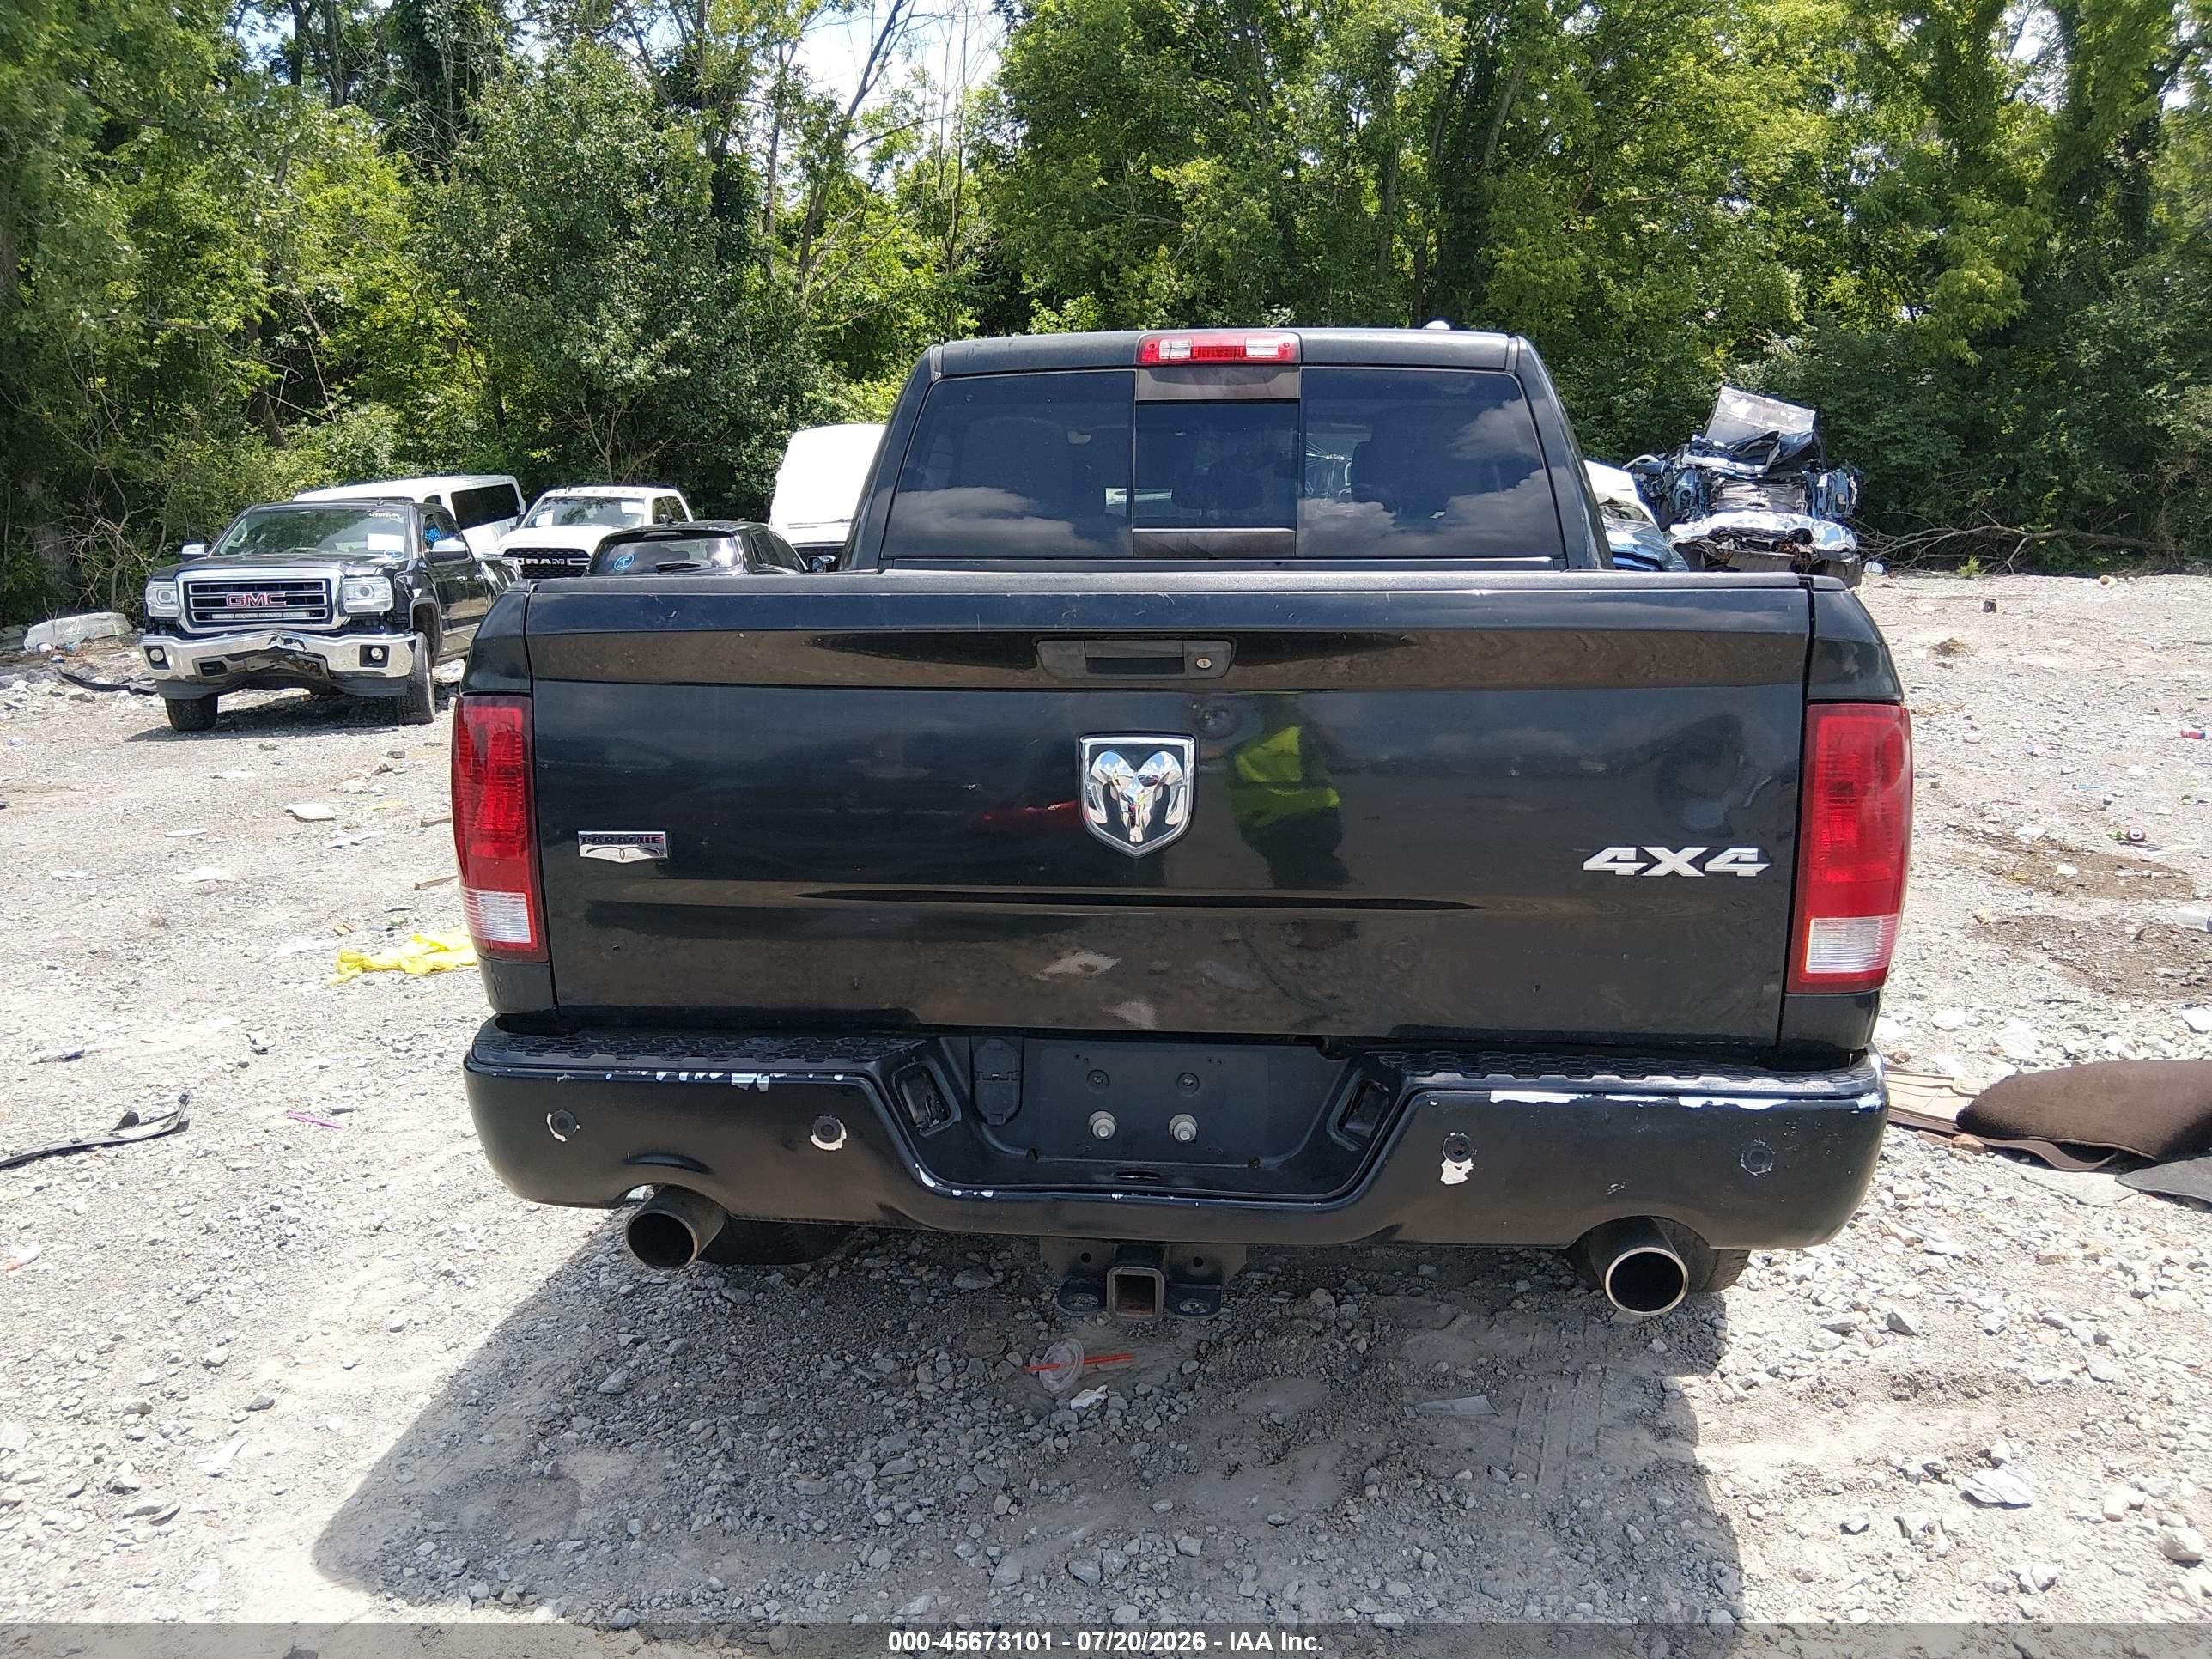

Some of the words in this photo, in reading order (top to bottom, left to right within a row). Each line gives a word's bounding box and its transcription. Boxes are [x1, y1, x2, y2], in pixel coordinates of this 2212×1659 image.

[526, 557, 565, 566] RAM
[225, 592, 288, 607] GMC
[580, 836, 663, 845] LARAMIE
[1582, 846, 1771, 878] 4X4
